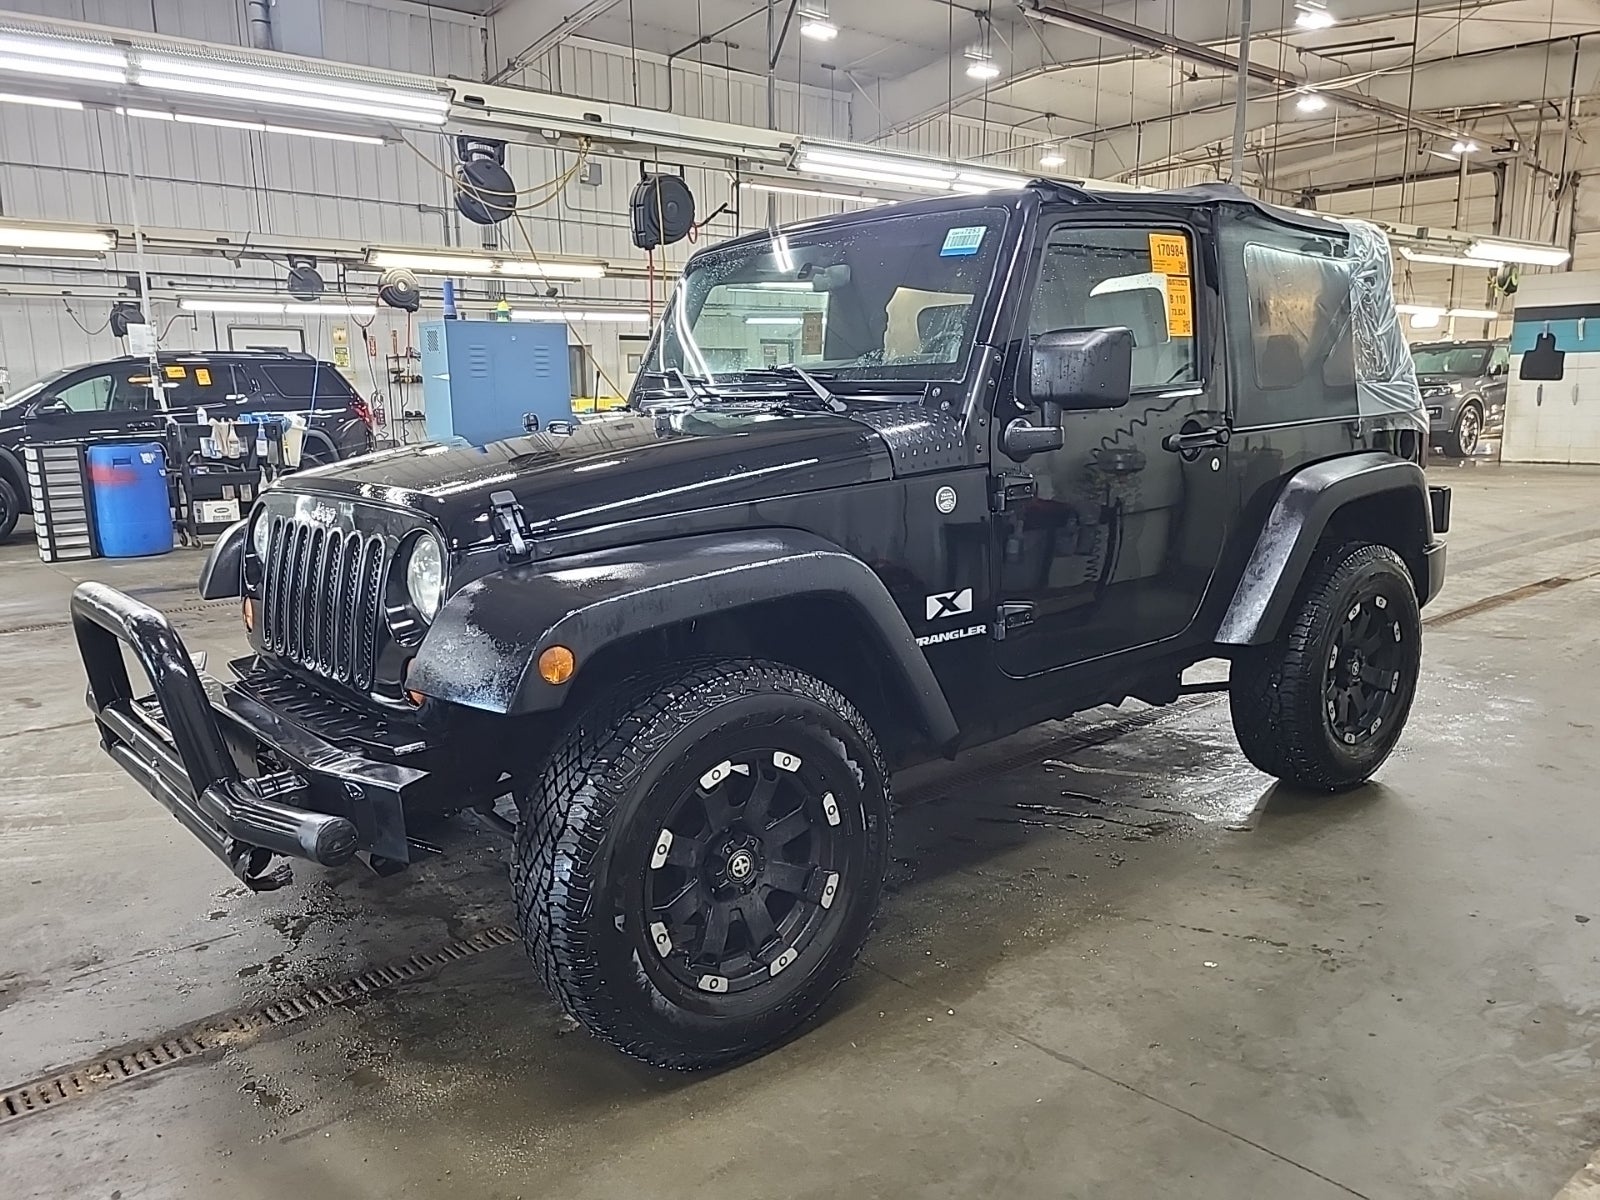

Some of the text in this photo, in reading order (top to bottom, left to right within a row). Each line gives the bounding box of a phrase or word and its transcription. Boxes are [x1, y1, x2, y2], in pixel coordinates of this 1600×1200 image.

[1157, 244, 1184, 257] 170984
[1176, 295, 1186, 304] 110
[928, 588, 970, 620] X
